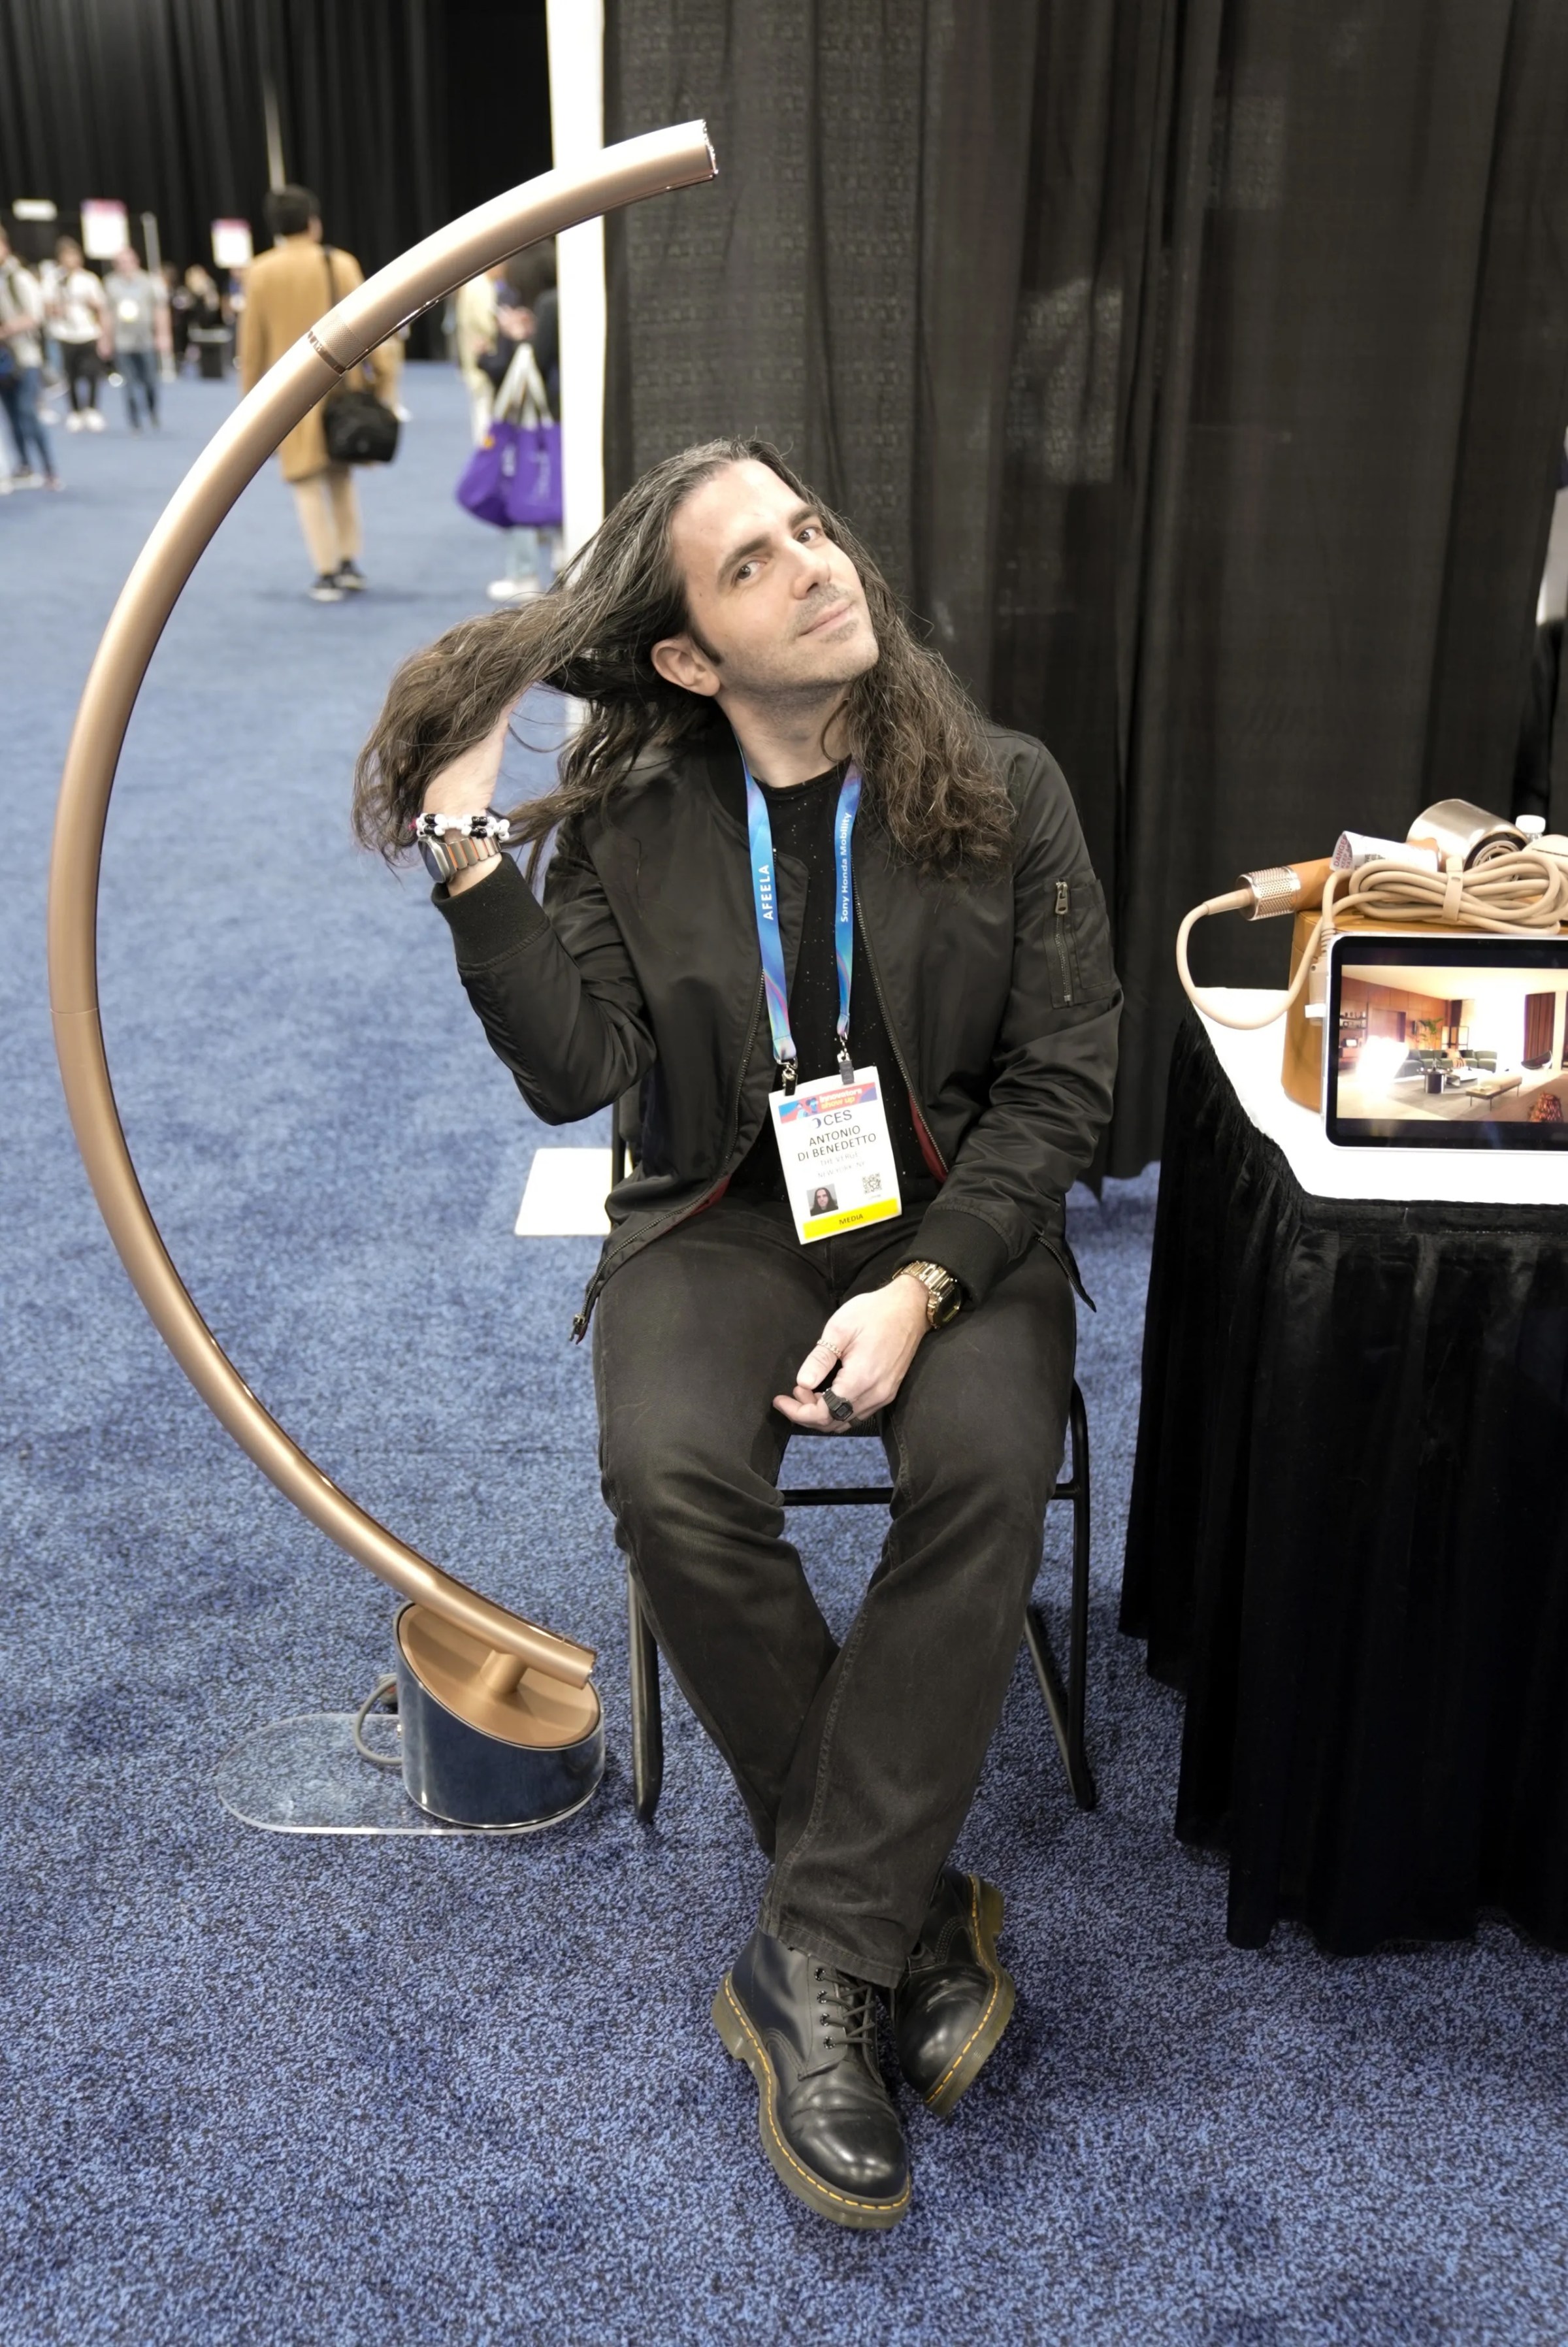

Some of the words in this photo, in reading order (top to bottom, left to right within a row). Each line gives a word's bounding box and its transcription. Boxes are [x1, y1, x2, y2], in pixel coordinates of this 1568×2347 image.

[840, 812, 852, 856] Mobility
[758, 864, 774, 921] AFEELA
[840, 895, 850, 923] Sony
[821, 1098, 843, 1109] show
[845, 1096, 855, 1105] up
[823, 1109, 853, 1126] CES
[797, 1151, 809, 1162] DI
[812, 1133, 876, 1158] BENEDETTO
[809, 1125, 860, 1146] ANTONIO
[839, 1213, 864, 1225] MEDIA
